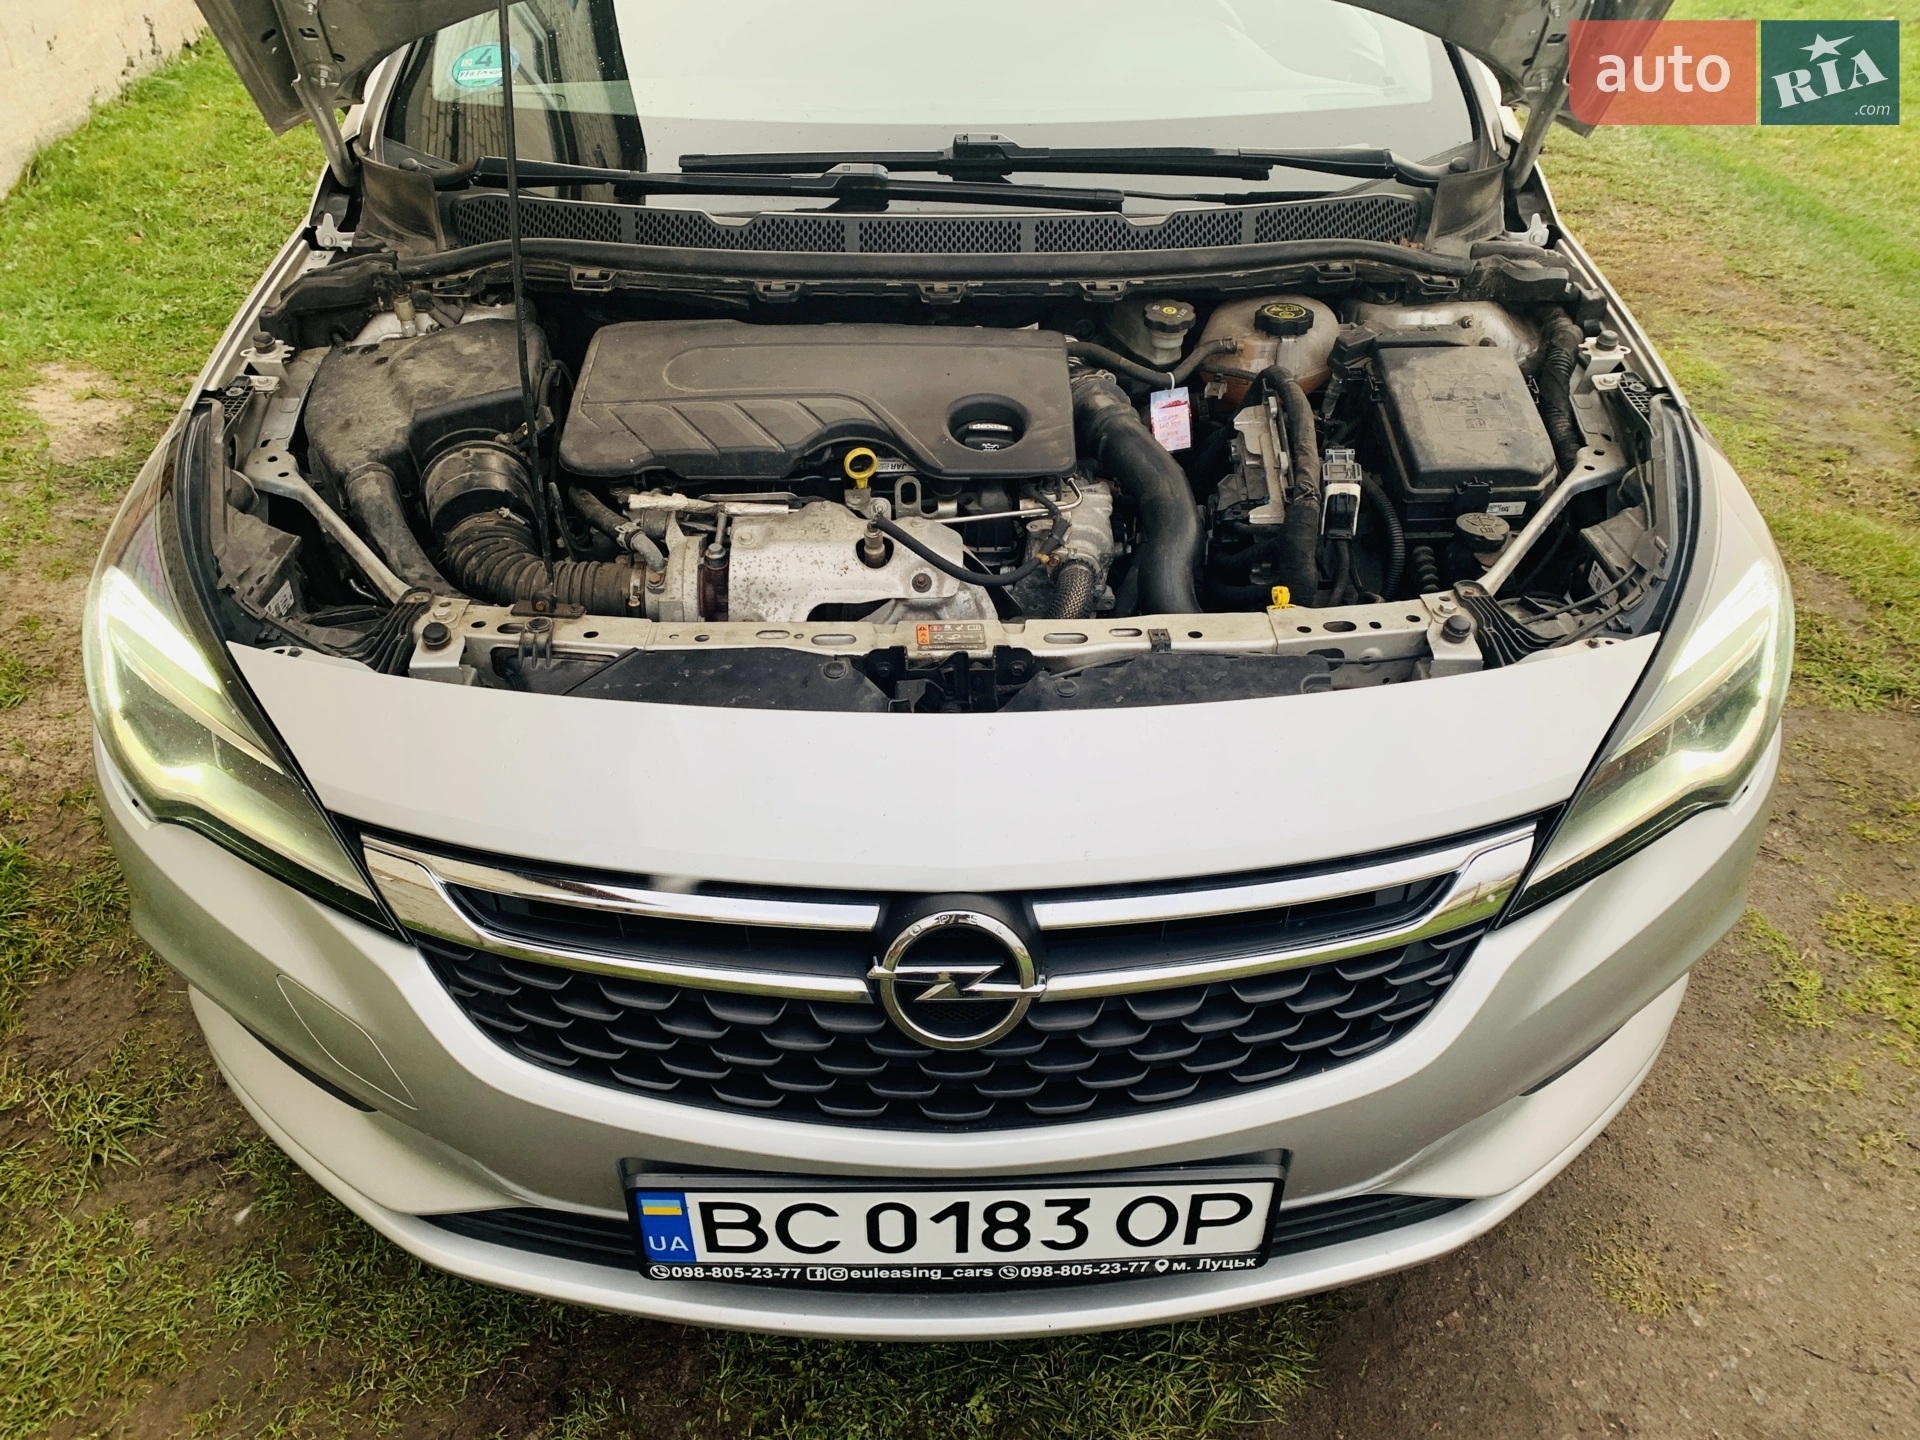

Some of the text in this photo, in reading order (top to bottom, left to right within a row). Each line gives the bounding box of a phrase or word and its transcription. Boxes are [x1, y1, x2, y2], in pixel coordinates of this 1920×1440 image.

[475, 48, 493, 67] 4
[909, 914, 1004, 937] OPEL
[698, 1192, 1254, 1255] BC 0183 OP
[648, 1235, 689, 1252] UA
[671, 1257, 1256, 1280] 098-805-23-77 euleasing_cars 098-805-23-77 м. Луцьк
